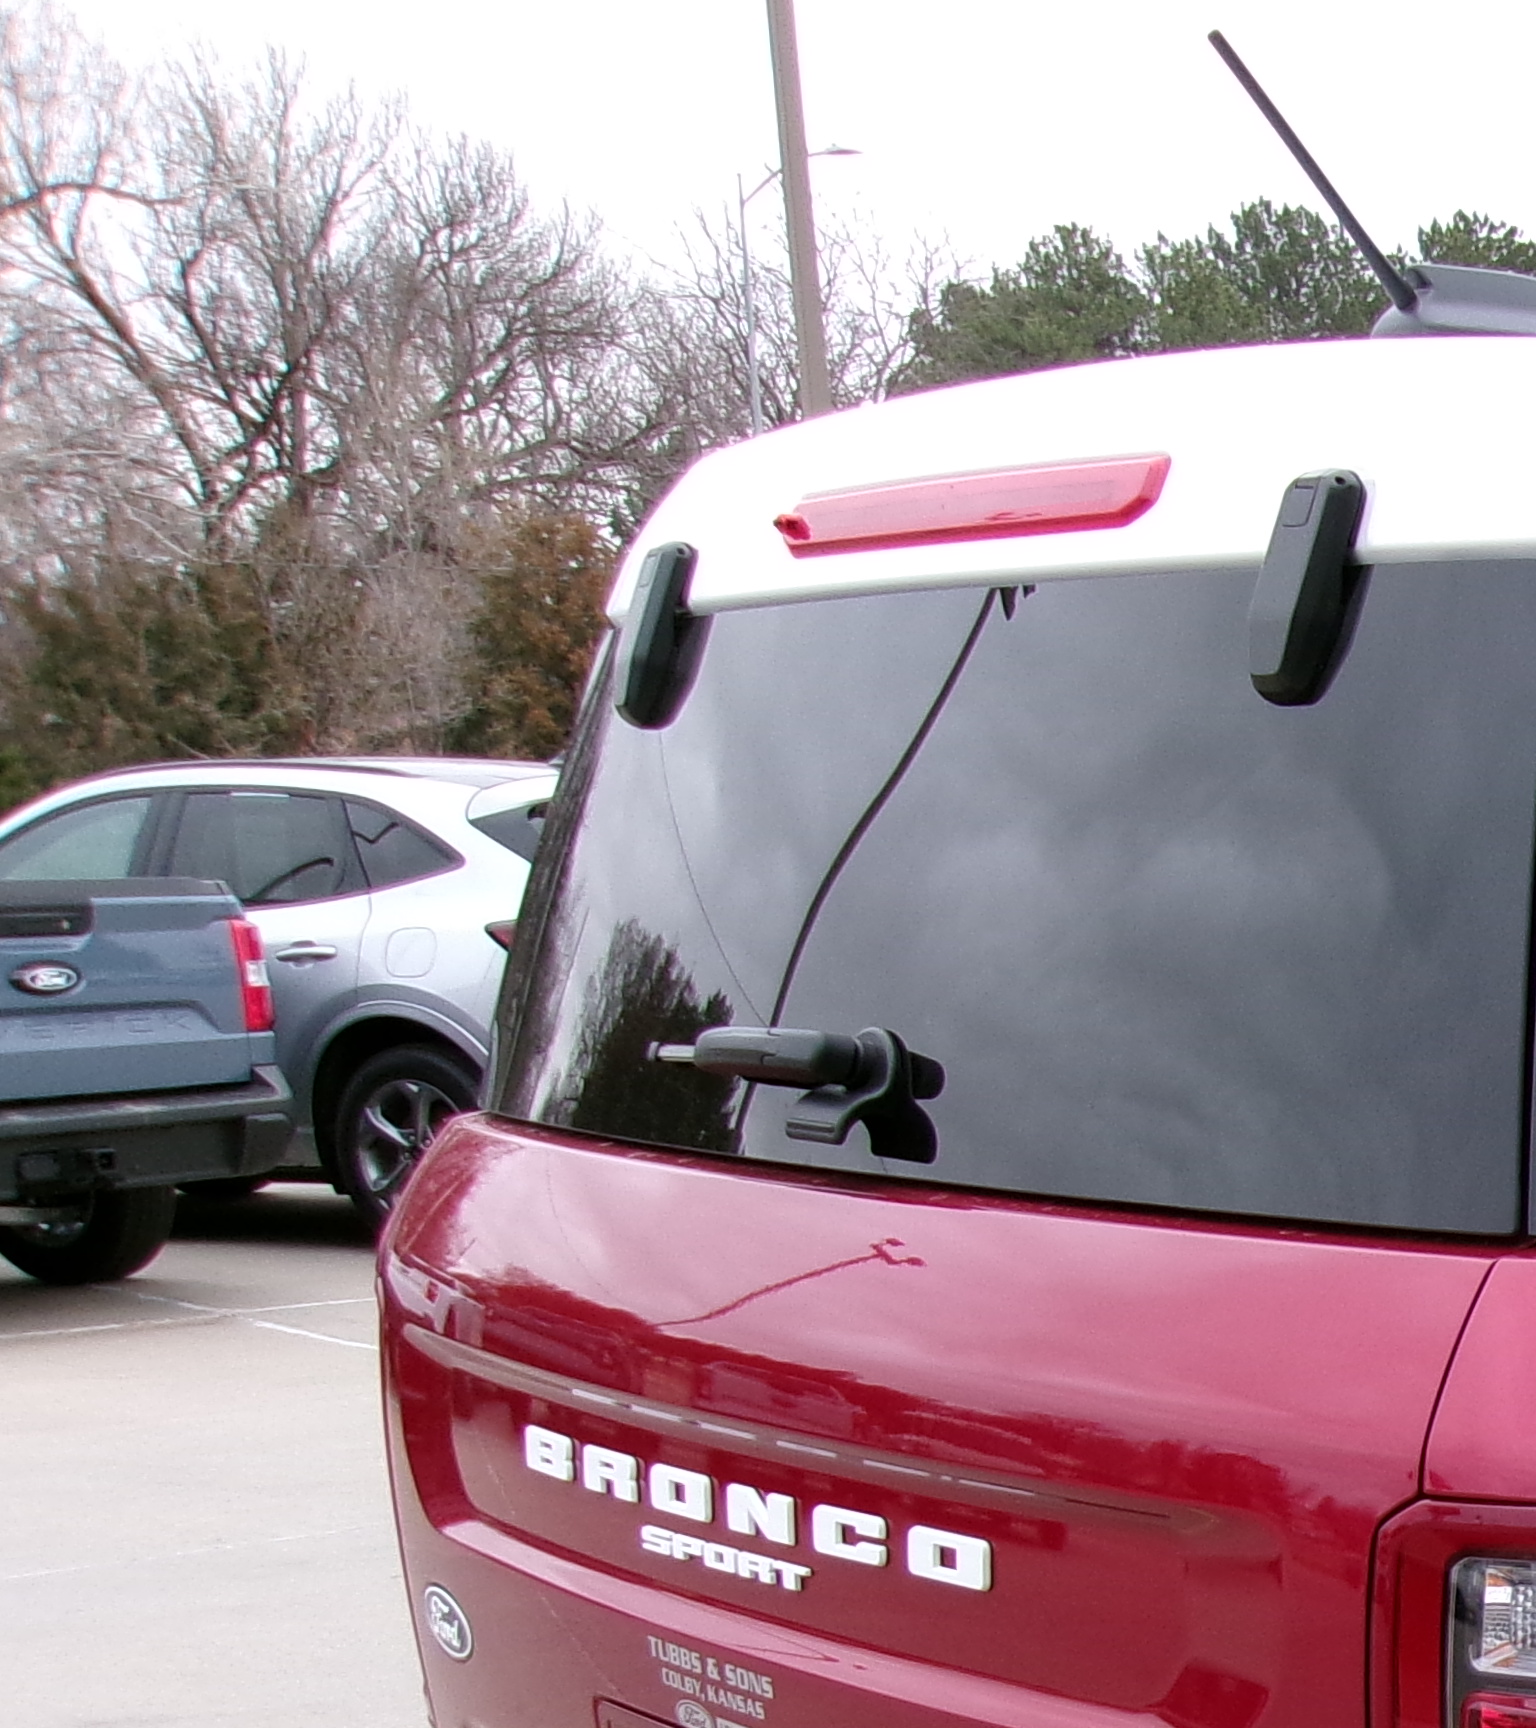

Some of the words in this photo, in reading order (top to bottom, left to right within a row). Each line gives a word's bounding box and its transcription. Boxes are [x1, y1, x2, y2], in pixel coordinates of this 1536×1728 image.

[524, 1424, 992, 1592] BRONCO
[640, 1524, 812, 1591] SPORT
[647, 1635, 703, 1674] TUBBS
[706, 1657, 721, 1681] &
[725, 1663, 774, 1699] SONS
[661, 1667, 705, 1702] COLBY,
[706, 1684, 765, 1720] KANSAS
